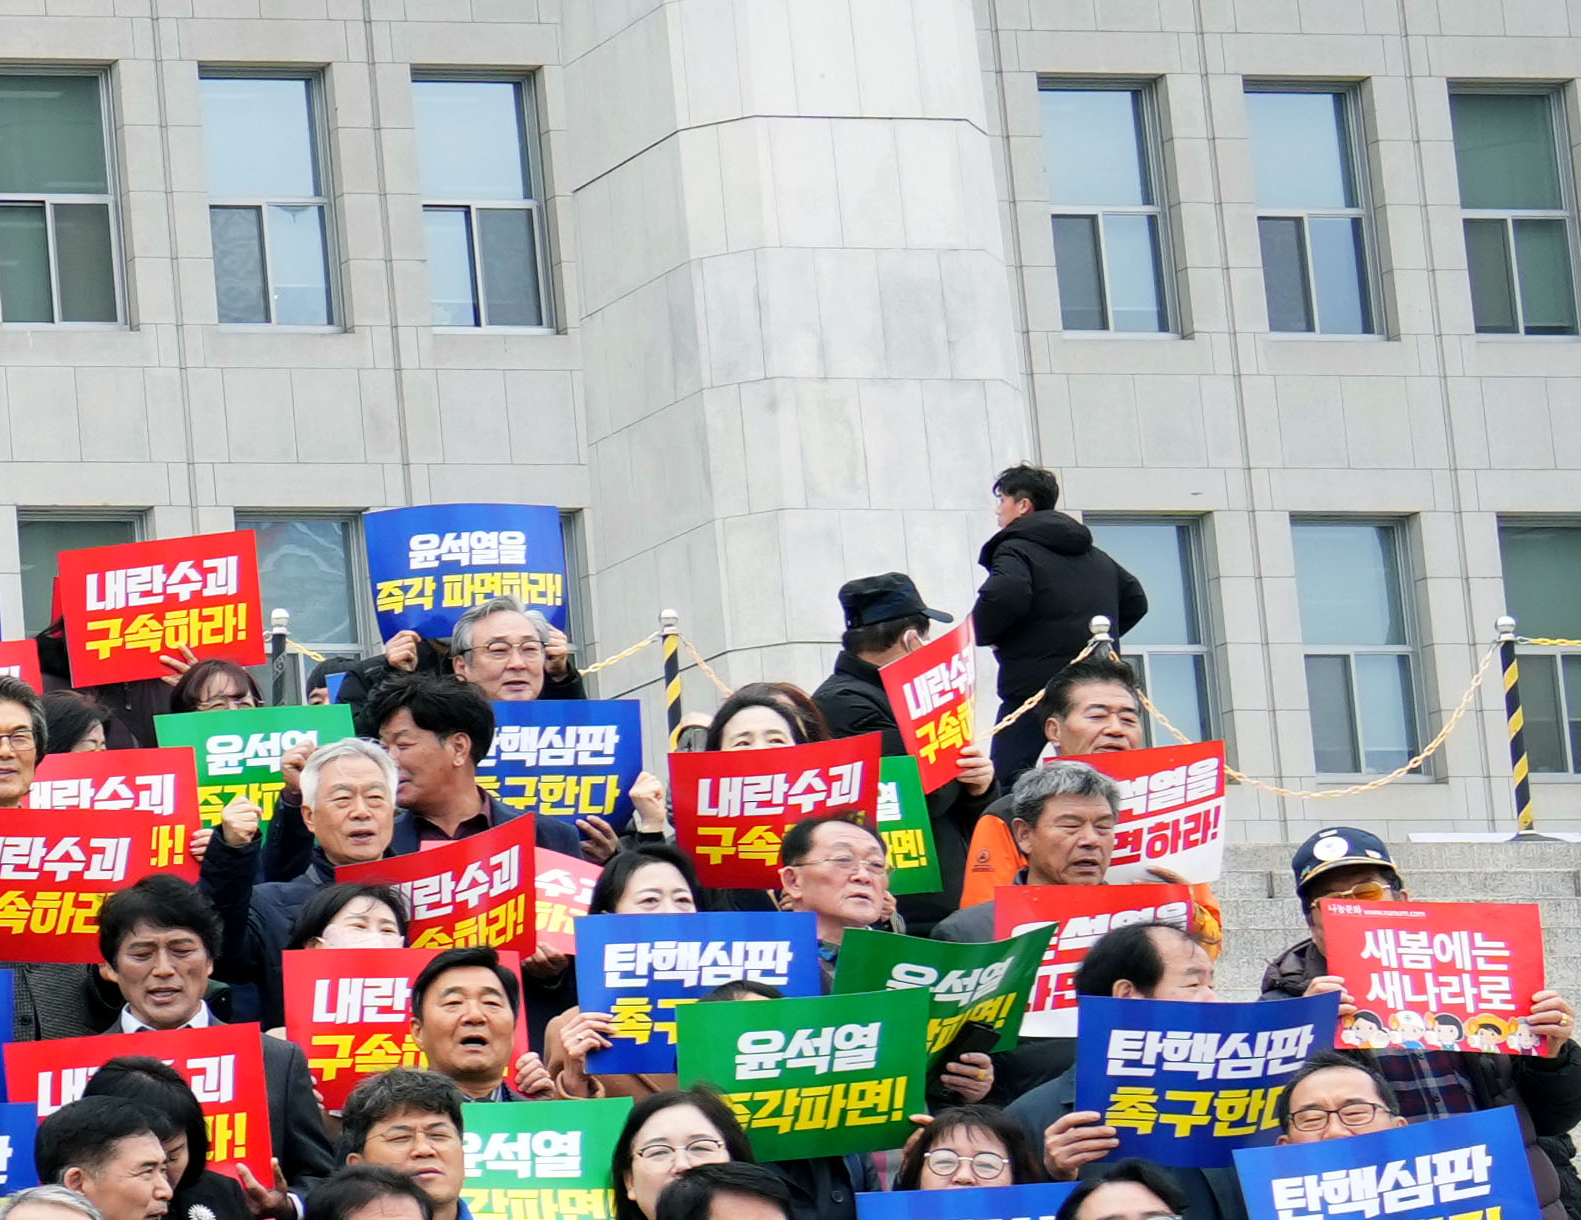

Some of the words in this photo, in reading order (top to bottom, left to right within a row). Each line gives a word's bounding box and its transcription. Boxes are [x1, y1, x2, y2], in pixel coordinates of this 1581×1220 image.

[409, 532, 527, 566] 윤석열을
[86, 557, 237, 609] 내란수괴
[377, 574, 434, 611] 즉각
[86, 605, 247, 658] 구속하라!
[697, 763, 861, 816] 내란수괴
[1119, 757, 1220, 818] 석열을
[1112, 808, 1222, 861] 면하라!
[399, 847, 520, 918] 란수괴
[604, 939, 793, 988] 탄핵심판
[1362, 929, 1511, 970] 새봄에는
[886, 956, 1013, 1005] 윤석열
[1365, 972, 1515, 1013] 새나라로
[735, 1021, 883, 1080] 윤석열
[1106, 1025, 1317, 1080] 탄핵심판
